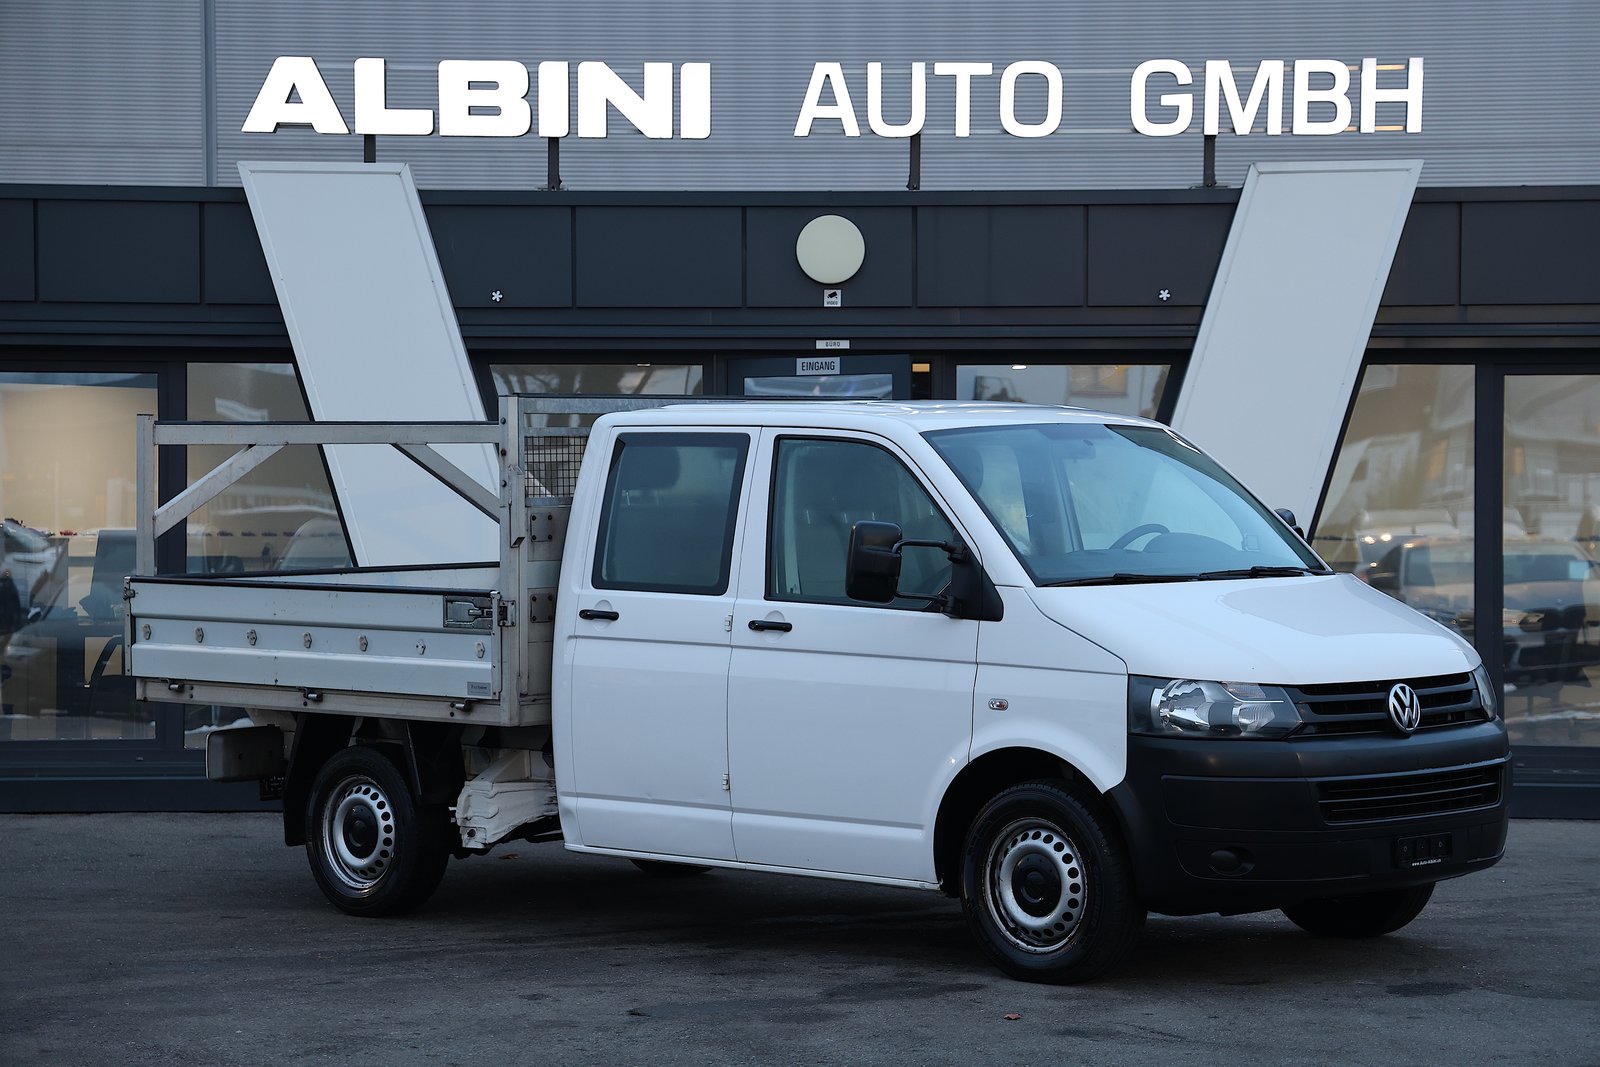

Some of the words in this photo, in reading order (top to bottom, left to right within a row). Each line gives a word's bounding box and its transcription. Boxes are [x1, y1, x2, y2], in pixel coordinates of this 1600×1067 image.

[241, 56, 711, 139] ALBINI
[794, 60, 1063, 137] AUTO
[1130, 57, 1424, 136] GMBH
[801, 361, 836, 371] EINGANG
[1389, 683, 1420, 731] VW
